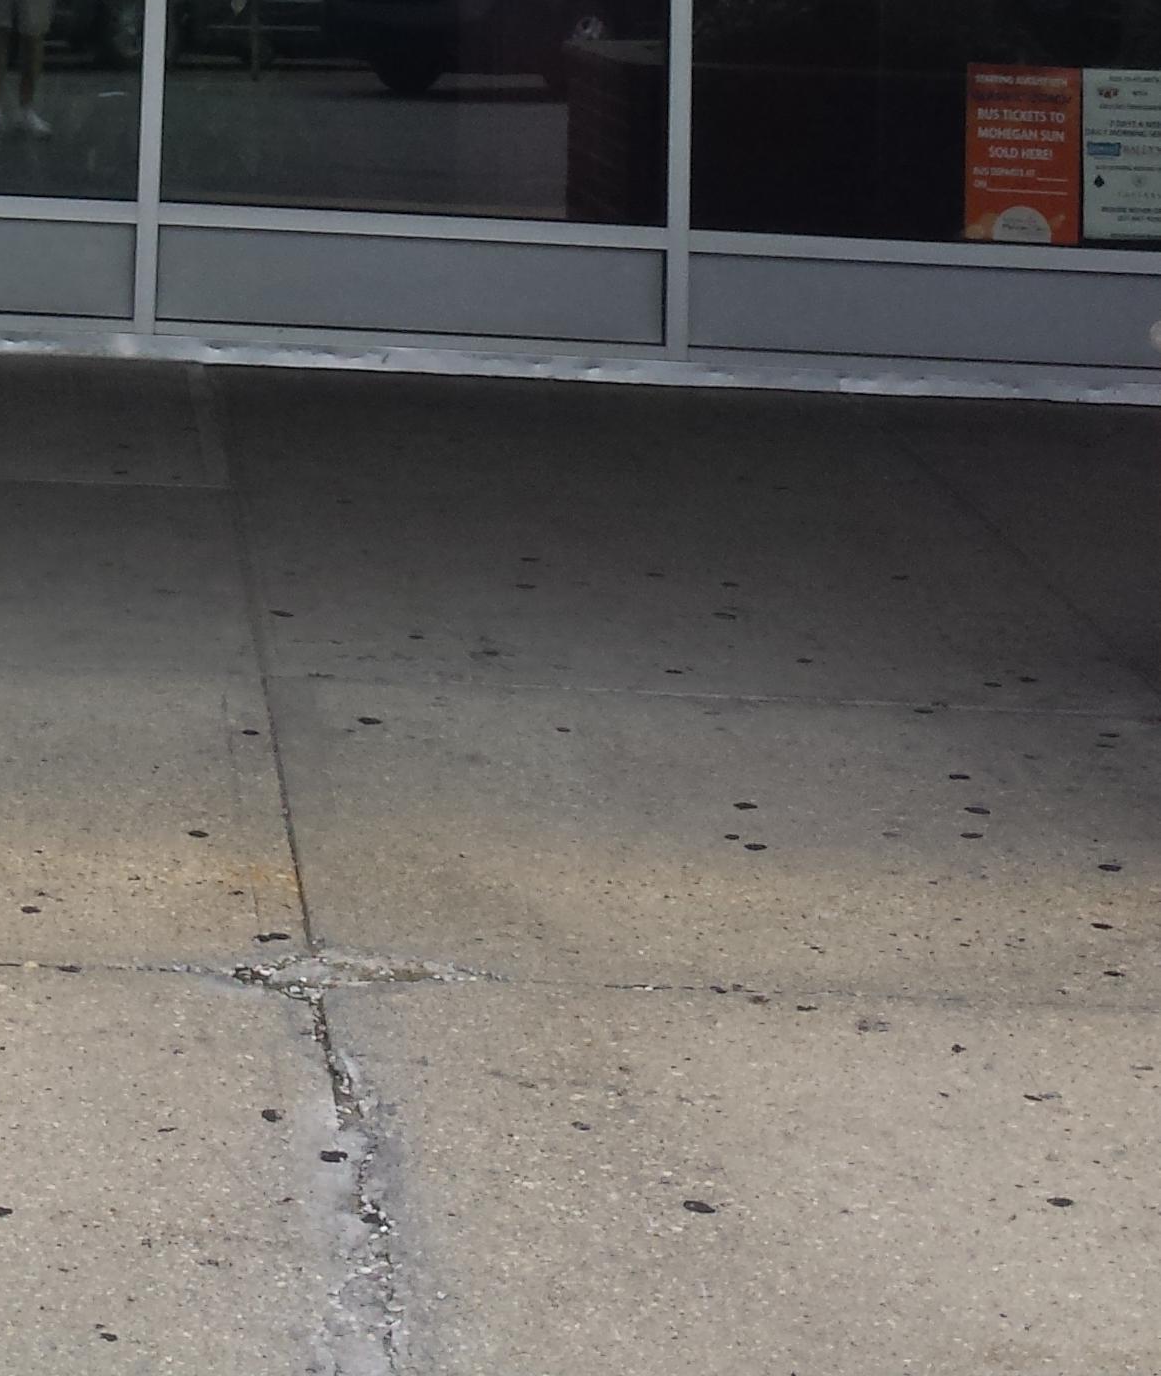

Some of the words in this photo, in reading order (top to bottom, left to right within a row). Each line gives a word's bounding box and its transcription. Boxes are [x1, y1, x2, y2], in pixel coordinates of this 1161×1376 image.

[977, 107, 1000, 121] BUS
[1002, 109, 1047, 122] TICKETS
[1049, 111, 1066, 124] TO
[977, 127, 1038, 141] MOHEGAN
[1041, 129, 1065, 143] SUN
[988, 145, 1018, 159] SOLD
[1021, 147, 1053, 160] HERE!
